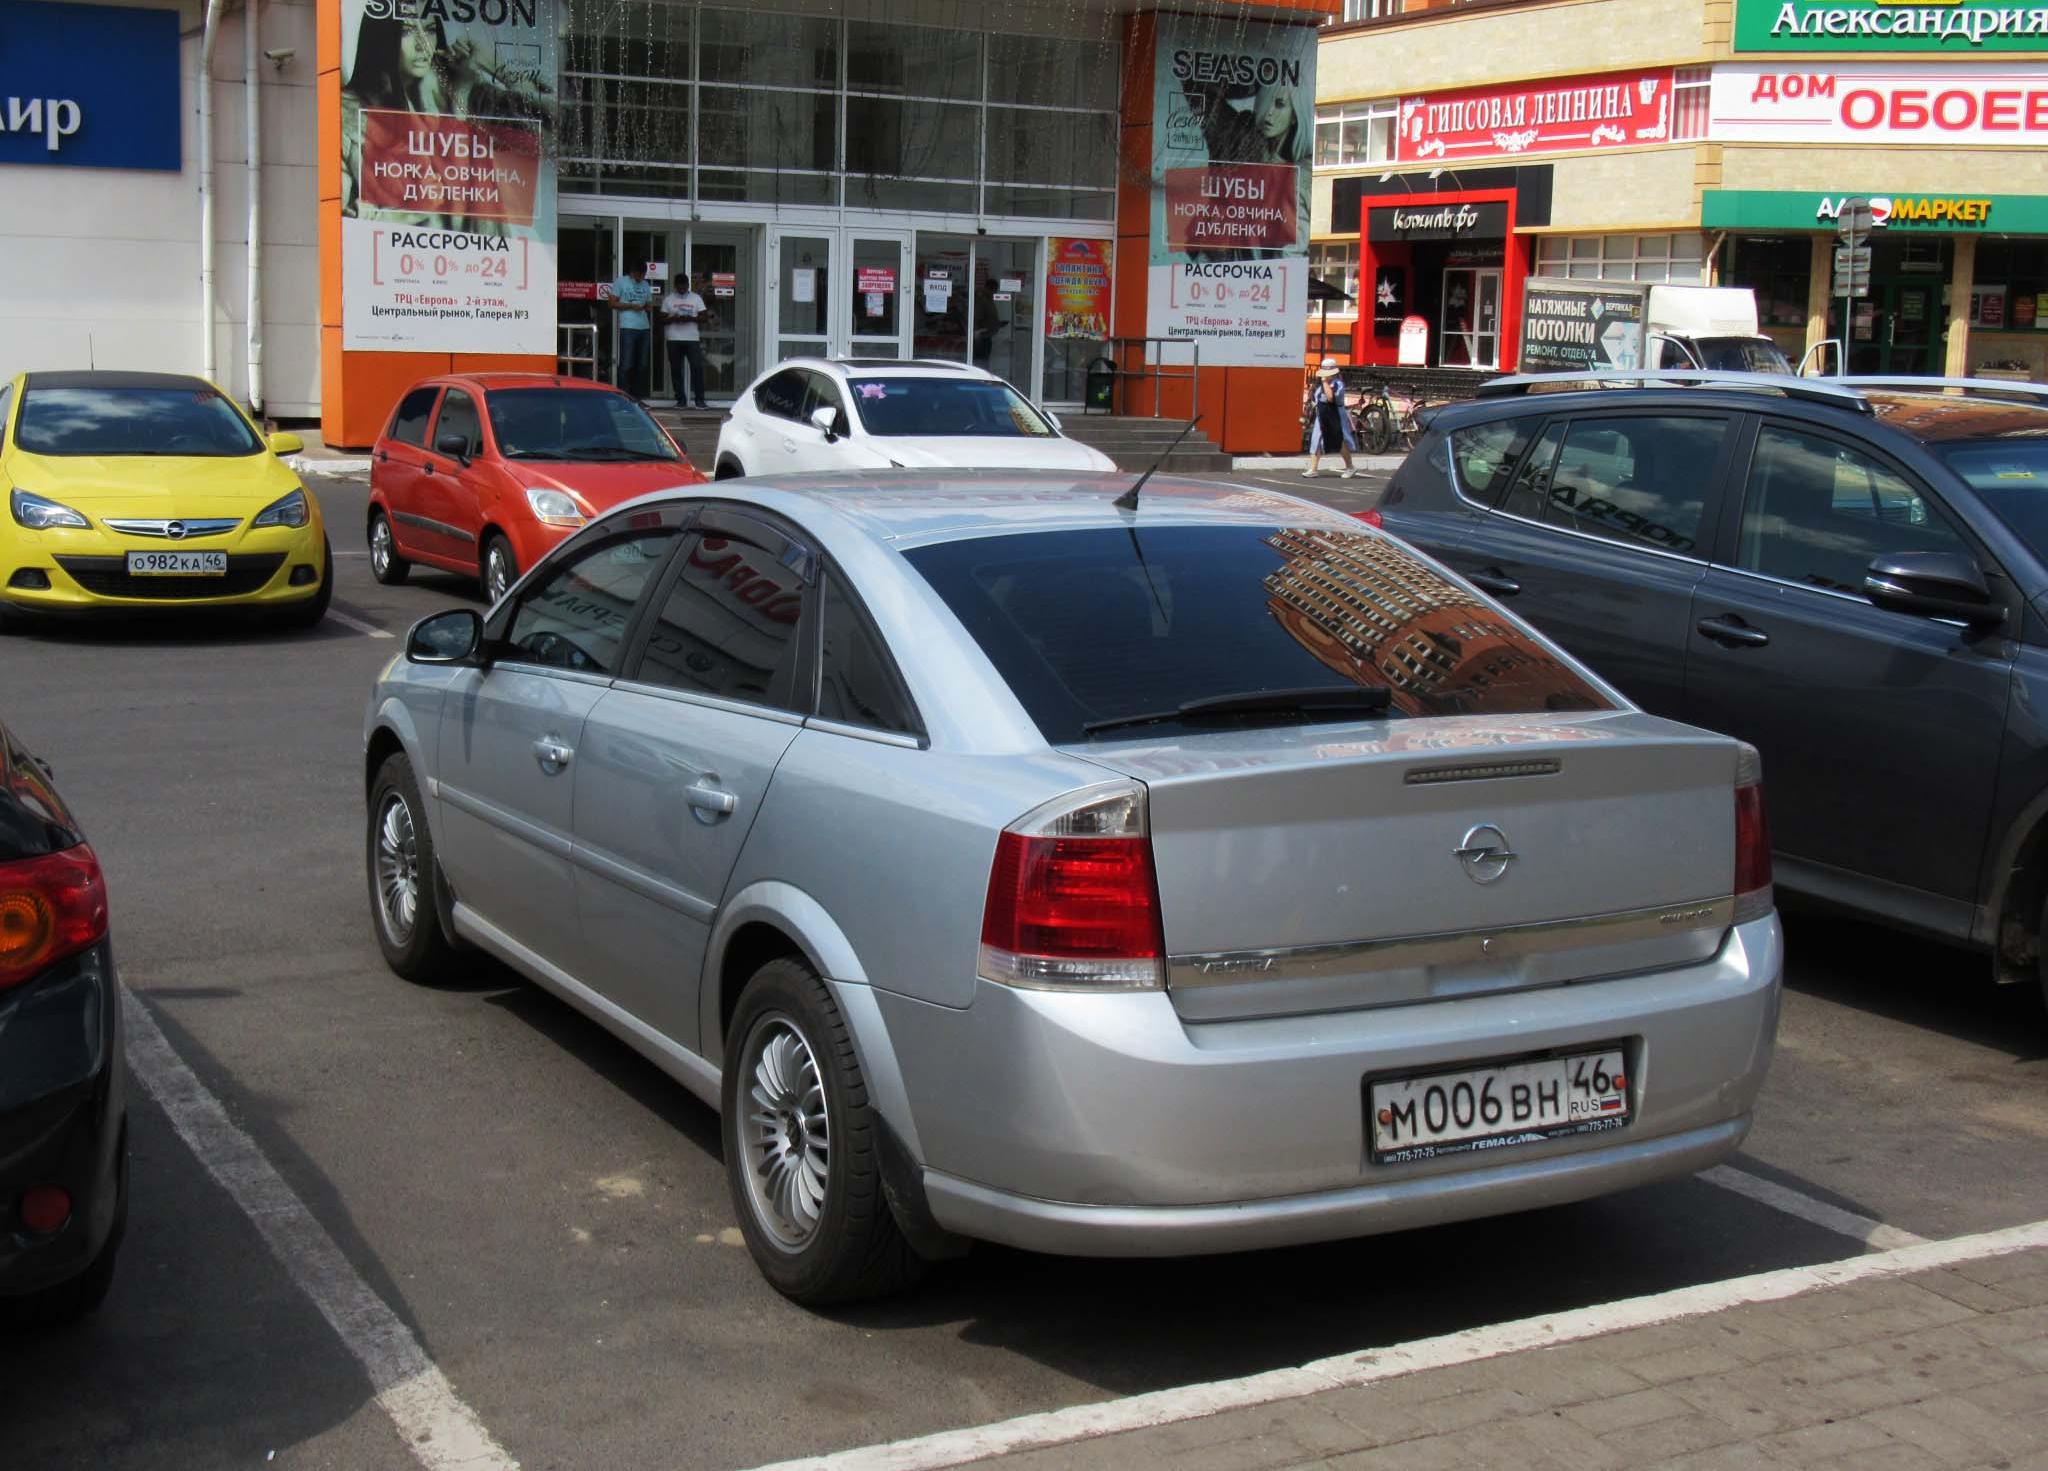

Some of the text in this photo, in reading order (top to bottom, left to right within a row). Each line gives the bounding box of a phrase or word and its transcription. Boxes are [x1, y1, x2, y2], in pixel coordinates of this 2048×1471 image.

[365, 0, 537, 28] SEASON
[1769, 2, 2048, 43] Александрия
[1172, 50, 1300, 88] SEASON
[1426, 83, 1633, 135] ГИПСОВАЯ ЛЕПНИНА
[0, 96, 81, 151] ир
[408, 130, 495, 159] ШУБЫ
[374, 162, 527, 187] НОРКА, ОВЧИНА,
[403, 184, 499, 203] ДУБЛЕНКИ
[1201, 175, 1265, 200] ШУБЫ
[1174, 203, 1287, 223] НОРКА, ОВЧИНА,
[1195, 221, 1267, 238] ДУБЛЕНКИ
[391, 231, 510, 252] РАССРОЧКА
[400, 253, 425, 276] 0%
[433, 254, 459, 277] 0%
[480, 256, 508, 278] 24
[1184, 262, 1273, 280] РАССРОЧКА
[394, 293, 412, 305] ТРЦ
[414, 294, 458, 308] «Европа»
[1251, 284, 1271, 302] 24
[372, 305, 529, 321] Центральный рынок, Галерея №3
[1528, 298, 1588, 317] НАТЯЖНЫЕ
[1185, 315, 1199, 327] ТРЦ
[1527, 318, 1596, 344] ПОТОЛКИ
[1168, 326, 1218, 337] Центральный
[1245, 327, 1273, 339] Галерея
[134, 553, 221, 570] О982КА 46
[1390, 1057, 1611, 1141] М006ВН 46
[1570, 1100, 1600, 1114] RUS
